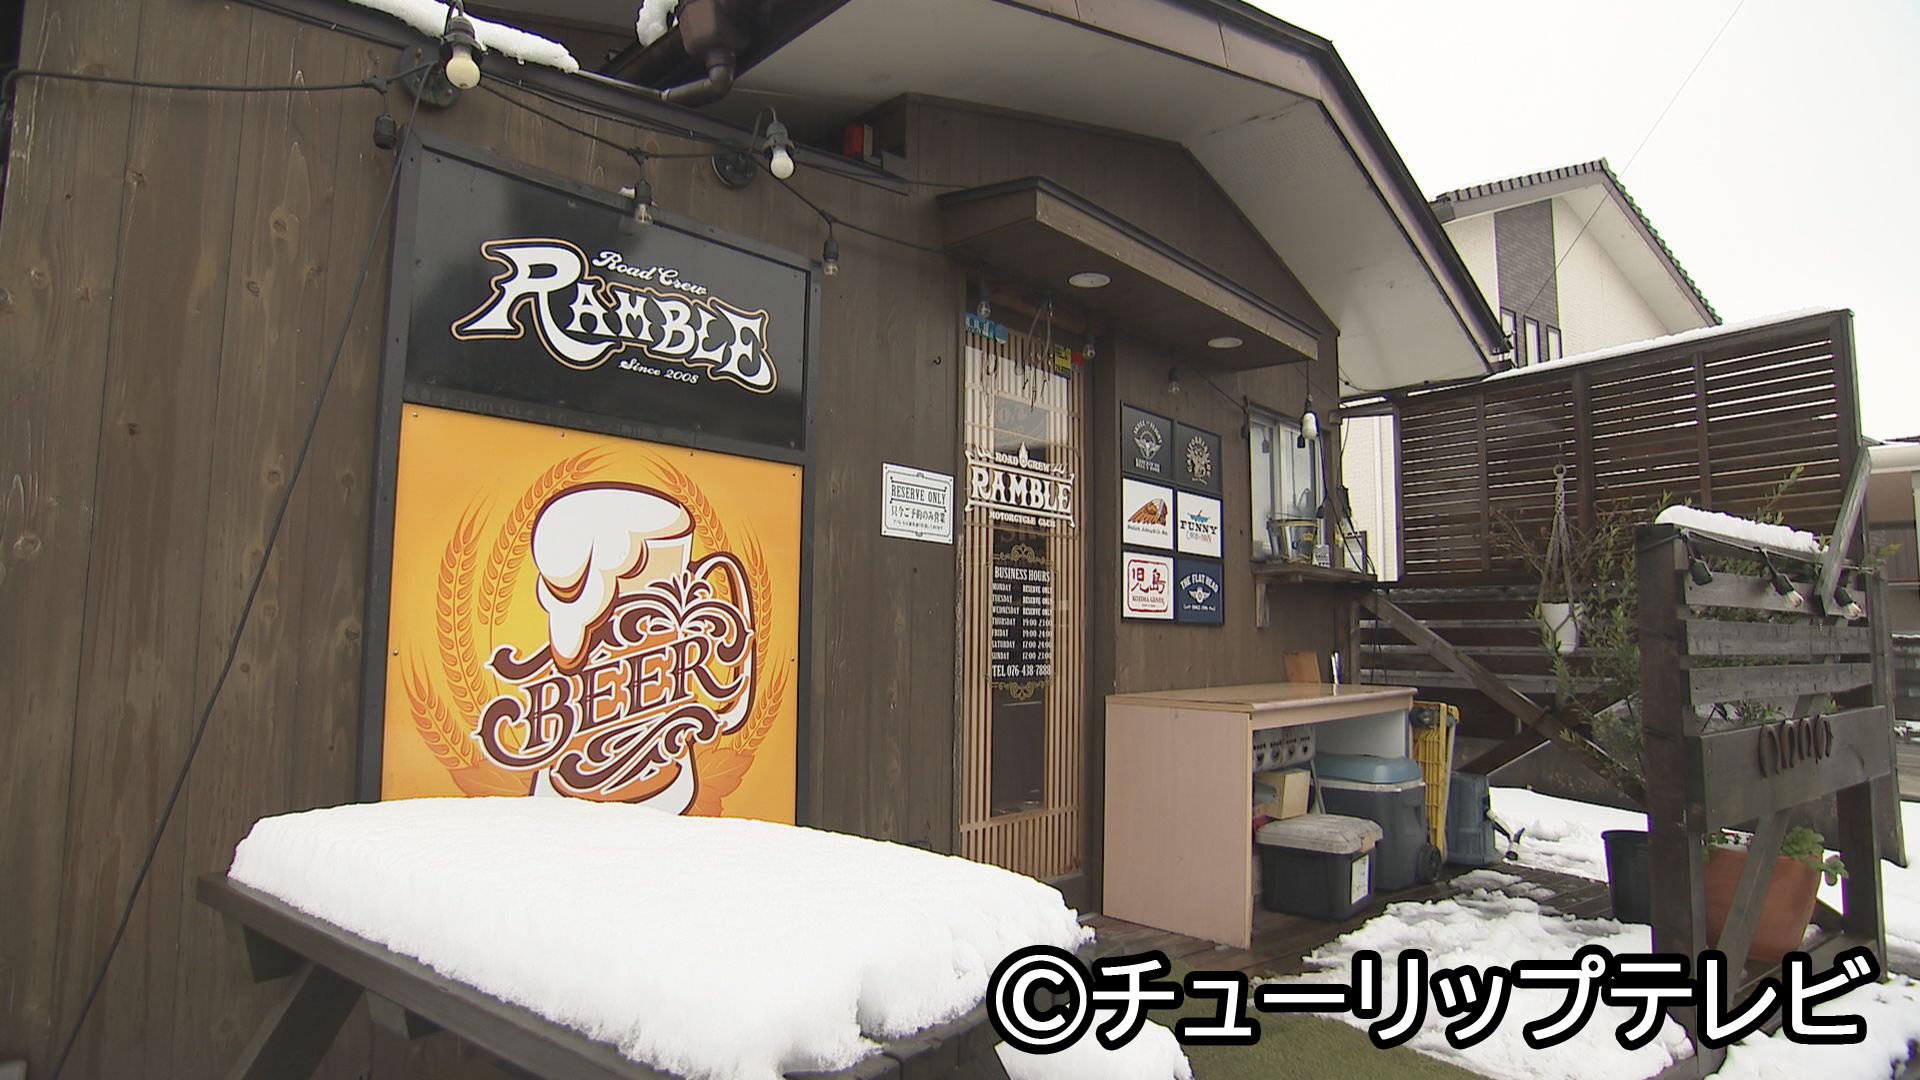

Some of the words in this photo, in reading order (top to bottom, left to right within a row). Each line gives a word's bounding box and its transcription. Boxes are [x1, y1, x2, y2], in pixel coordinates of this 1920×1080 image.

[592, 250, 654, 283] Road
[655, 266, 708, 296] Crew
[458, 244, 774, 389] RAMBLE
[618, 357, 661, 377] Since
[663, 368, 700, 386] 2008
[994, 452, 1019, 467] ROAD
[1027, 459, 1051, 474] CREW
[891, 484, 925, 502] RESERVE
[927, 491, 946, 506] ONLY
[970, 466, 1072, 514] RAMBLE
[994, 566, 1028, 581] BUSINESS
[1028, 568, 1051, 583] HOURS
[1130, 567, 1166, 594] 児島
[1179, 575, 1192, 591] THE
[1191, 573, 1206, 584] FLAT
[991, 664, 1006, 678] TEL
[477, 636, 747, 769] BEER
